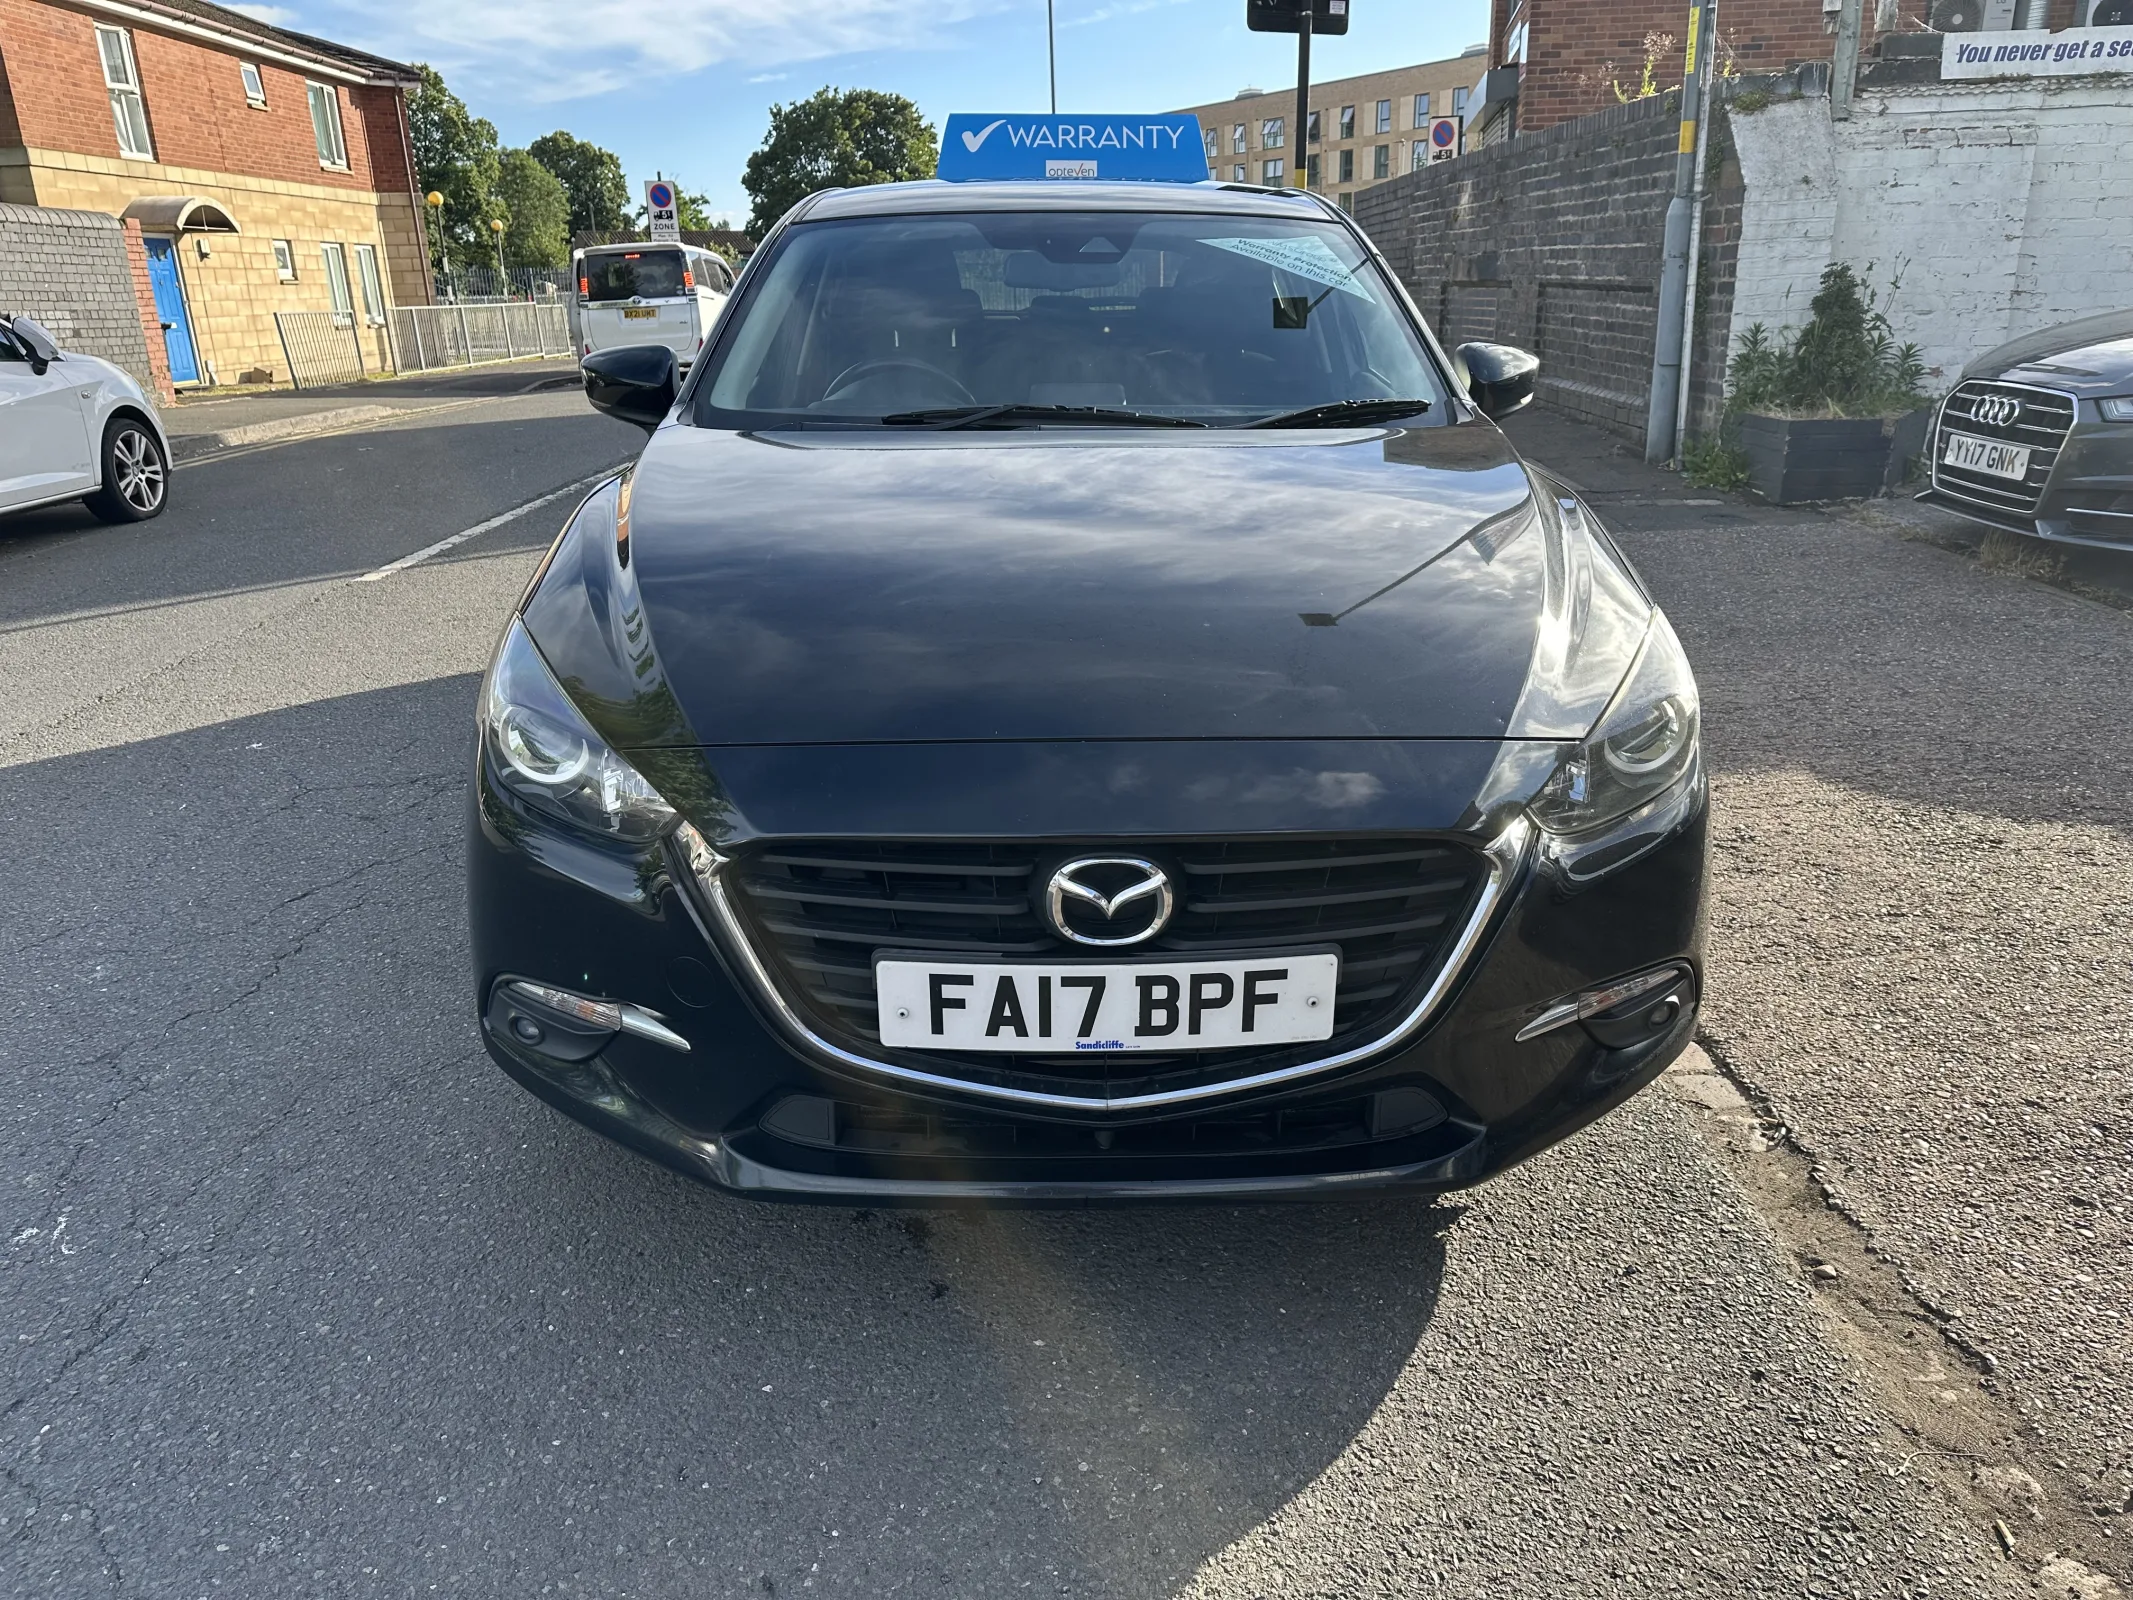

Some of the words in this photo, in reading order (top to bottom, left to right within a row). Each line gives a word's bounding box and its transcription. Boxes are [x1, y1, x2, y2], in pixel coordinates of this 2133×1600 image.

[1957, 44, 1992, 63] You
[1993, 44, 2052, 62] never
[2052, 40, 2089, 62] get
[2090, 41, 2105, 58] a
[2106, 40, 2133, 57] se
[1007, 124, 1184, 149] WARRANTY
[1230, 244, 1284, 264] Available
[1287, 261, 1303, 272] on
[1305, 267, 1326, 280] this
[1328, 276, 1348, 288] car
[1238, 239, 1290, 259] Warranty
[1294, 256, 1352, 282] Protection
[1955, 439, 1986, 465] YY17
[1987, 446, 2020, 473] GNK
[928, 973, 1107, 1038] FA17
[1134, 969, 1289, 1037] BPF
[1075, 1040, 1124, 1050] Sandicliffe
